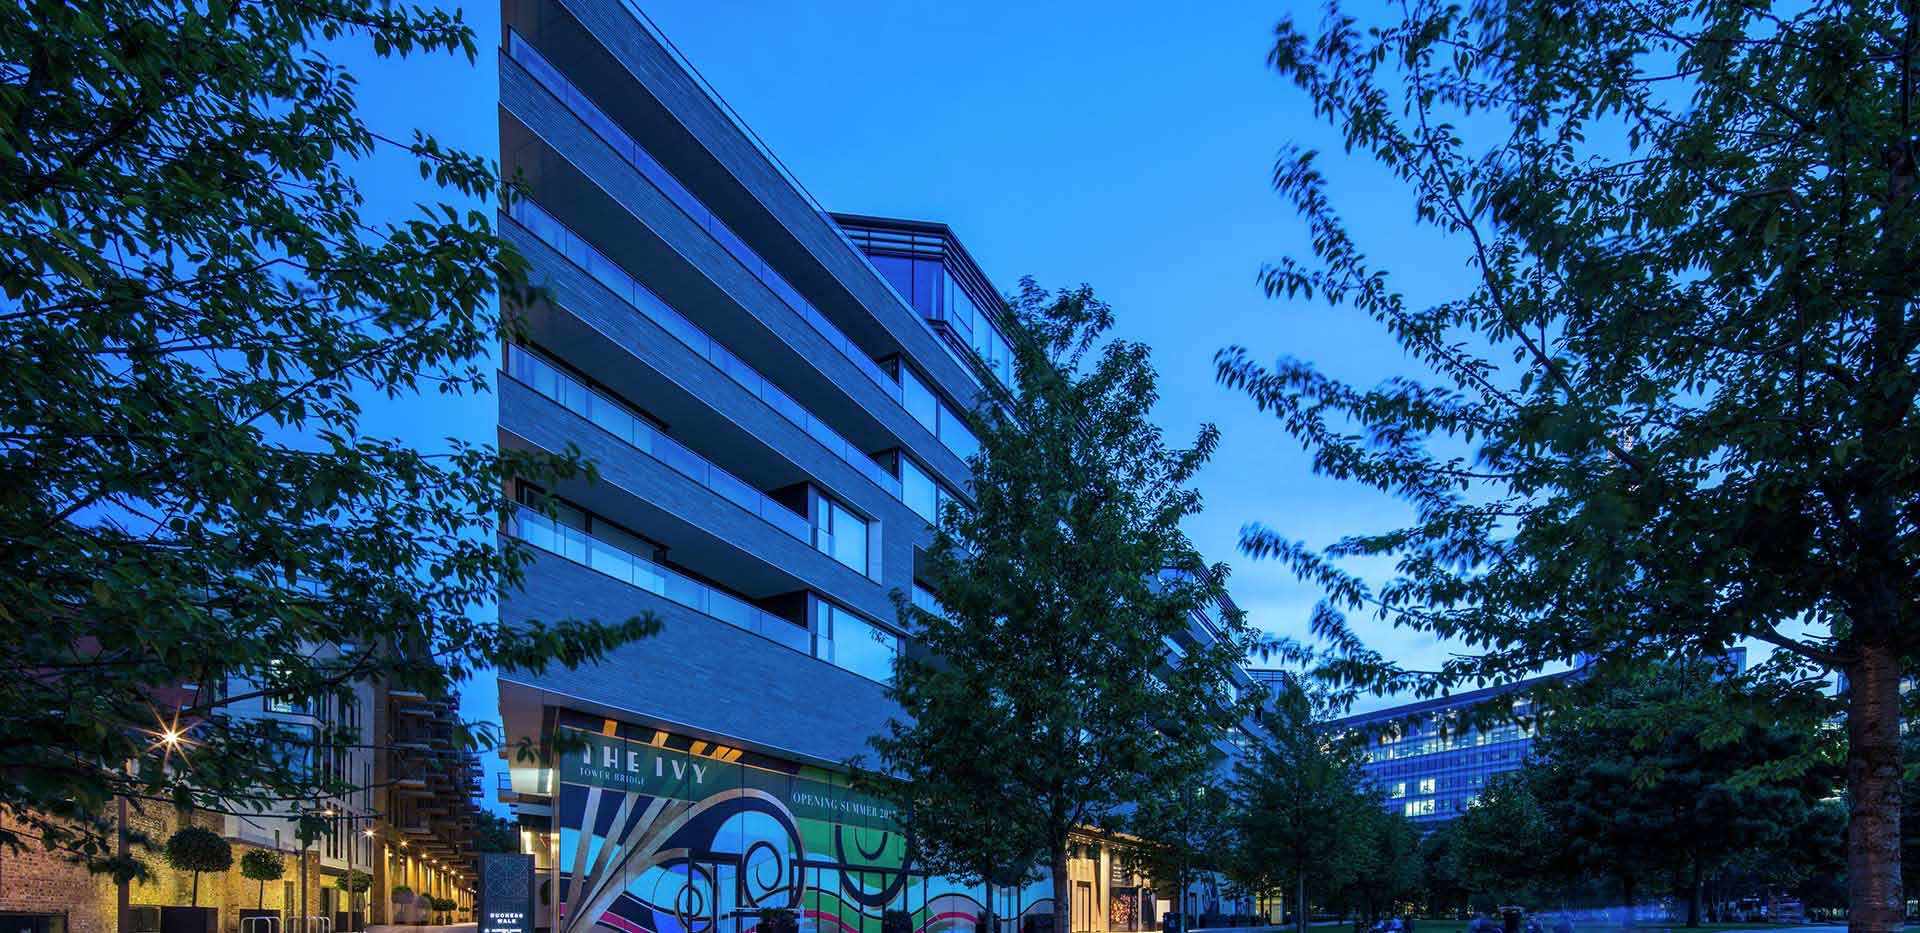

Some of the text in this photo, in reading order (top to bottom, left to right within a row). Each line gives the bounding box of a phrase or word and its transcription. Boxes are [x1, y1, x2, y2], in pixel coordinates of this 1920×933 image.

[580, 767, 647, 785] TOWER BRIDGE
[583, 742, 706, 784] THE IVY
[793, 791, 837, 809] OPENING
[840, 799, 877, 817] SUMMER
